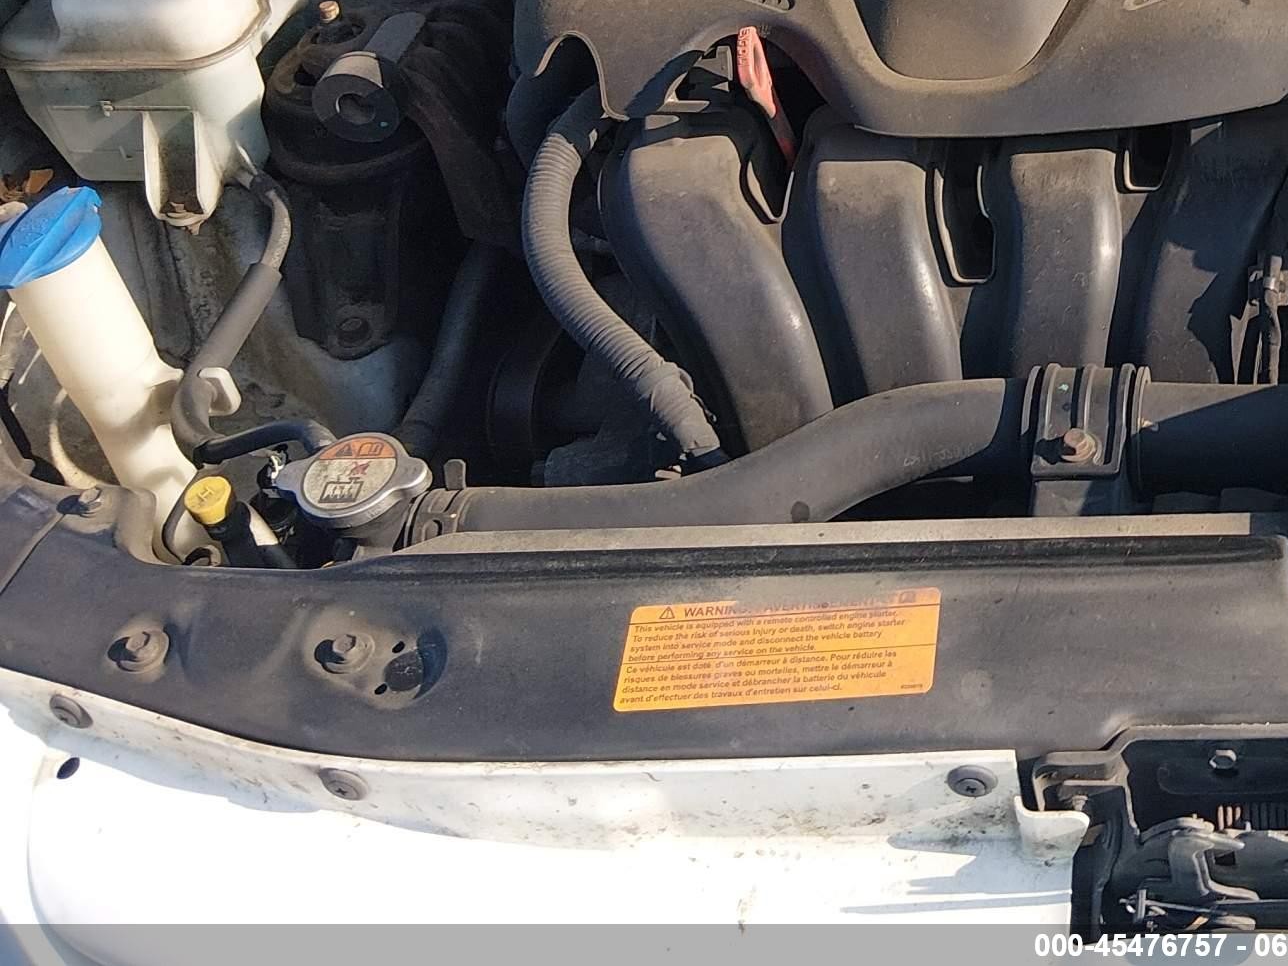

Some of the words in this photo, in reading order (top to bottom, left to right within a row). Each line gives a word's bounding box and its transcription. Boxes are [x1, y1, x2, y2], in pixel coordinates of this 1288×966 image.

[644, 633, 674, 641] reduce
[719, 628, 750, 637] serious
[789, 624, 816, 634] death,
[817, 622, 845, 630] switch
[847, 620, 876, 630] engine
[877, 618, 906, 626] starter
[654, 623, 684, 631] vehicle
[694, 620, 734, 630] equipped
[762, 616, 792, 624] remote
[838, 611, 869, 621] engine
[629, 644, 660, 654] system
[680, 641, 711, 649] service
[713, 639, 737, 647] mode
[756, 635, 803, 644] disconnect
[820, 632, 851, 640] vehicle
[852, 630, 882, 639] battery
[626, 665, 639, 673] Ce
[677, 662, 690, 670] est
[692, 661, 711, 669] doté
[789, 653, 828, 662] distance.
[830, 652, 851, 660] Pour
[628, 654, 655, 662] before
[656, 651, 704, 661] performing
[784, 643, 816, 652] vehicle.
[621, 684, 658, 693] distance
[672, 682, 696, 690] mode
[698, 680, 729, 688] service
[802, 673, 835, 682] batterie
[623, 675, 656, 685] risques
[670, 671, 712, 680] blessures
[713, 671, 742, 679] graves
[757, 665, 800, 676] mortelles,
[802, 663, 829, 672] mettre
[619, 695, 644, 703] avant
[692, 691, 708, 699] des
[711, 689, 742, 697] travaux
[808, 683, 842, 691] celui-ci.
